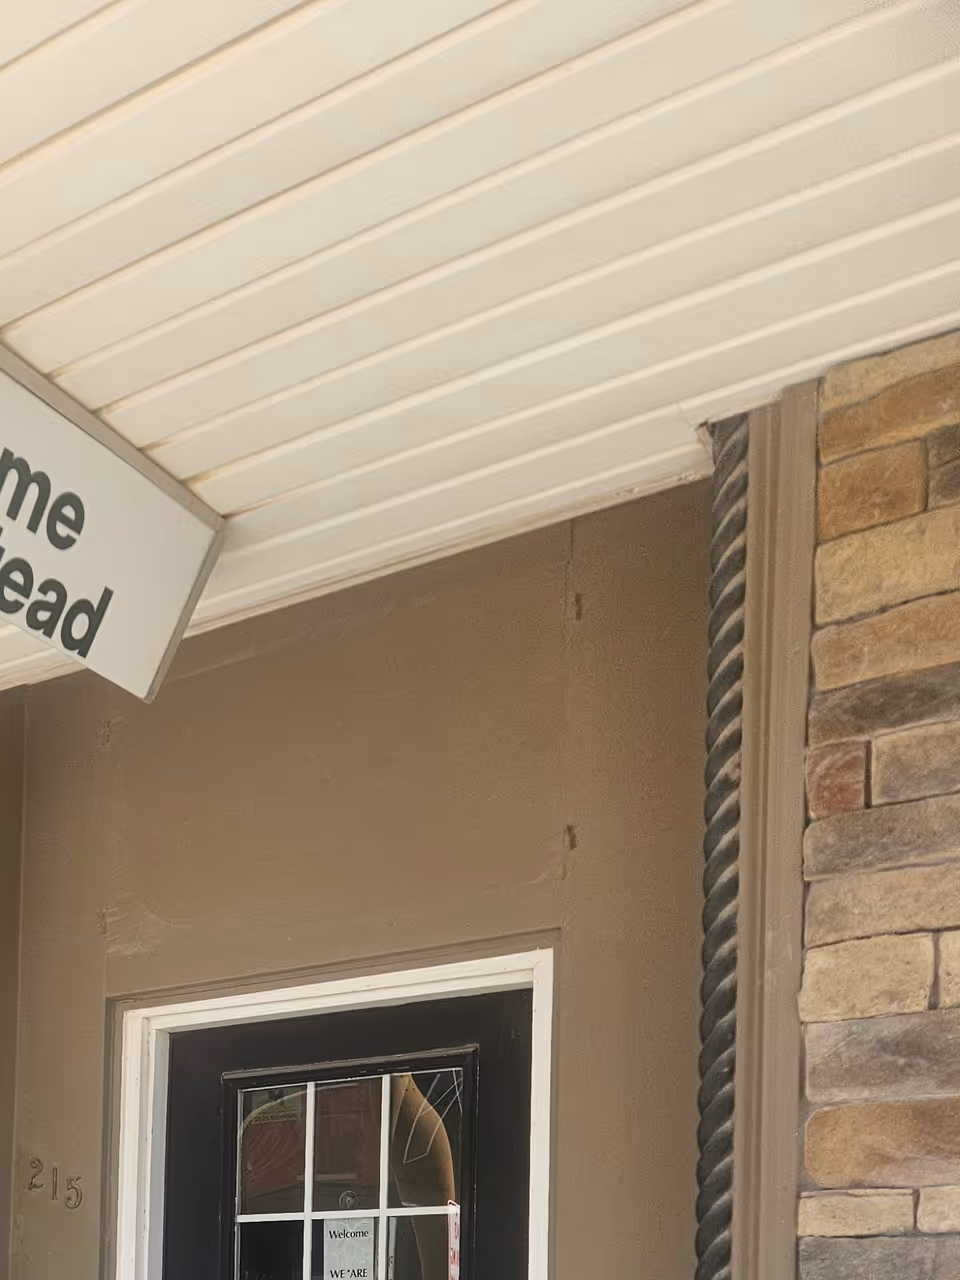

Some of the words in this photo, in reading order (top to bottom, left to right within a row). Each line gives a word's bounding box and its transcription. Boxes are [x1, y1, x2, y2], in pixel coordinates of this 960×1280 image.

[27, 1156, 83, 1210] 215
[328, 1229, 370, 1240] Welcome
[330, 1269, 346, 1279] WE
